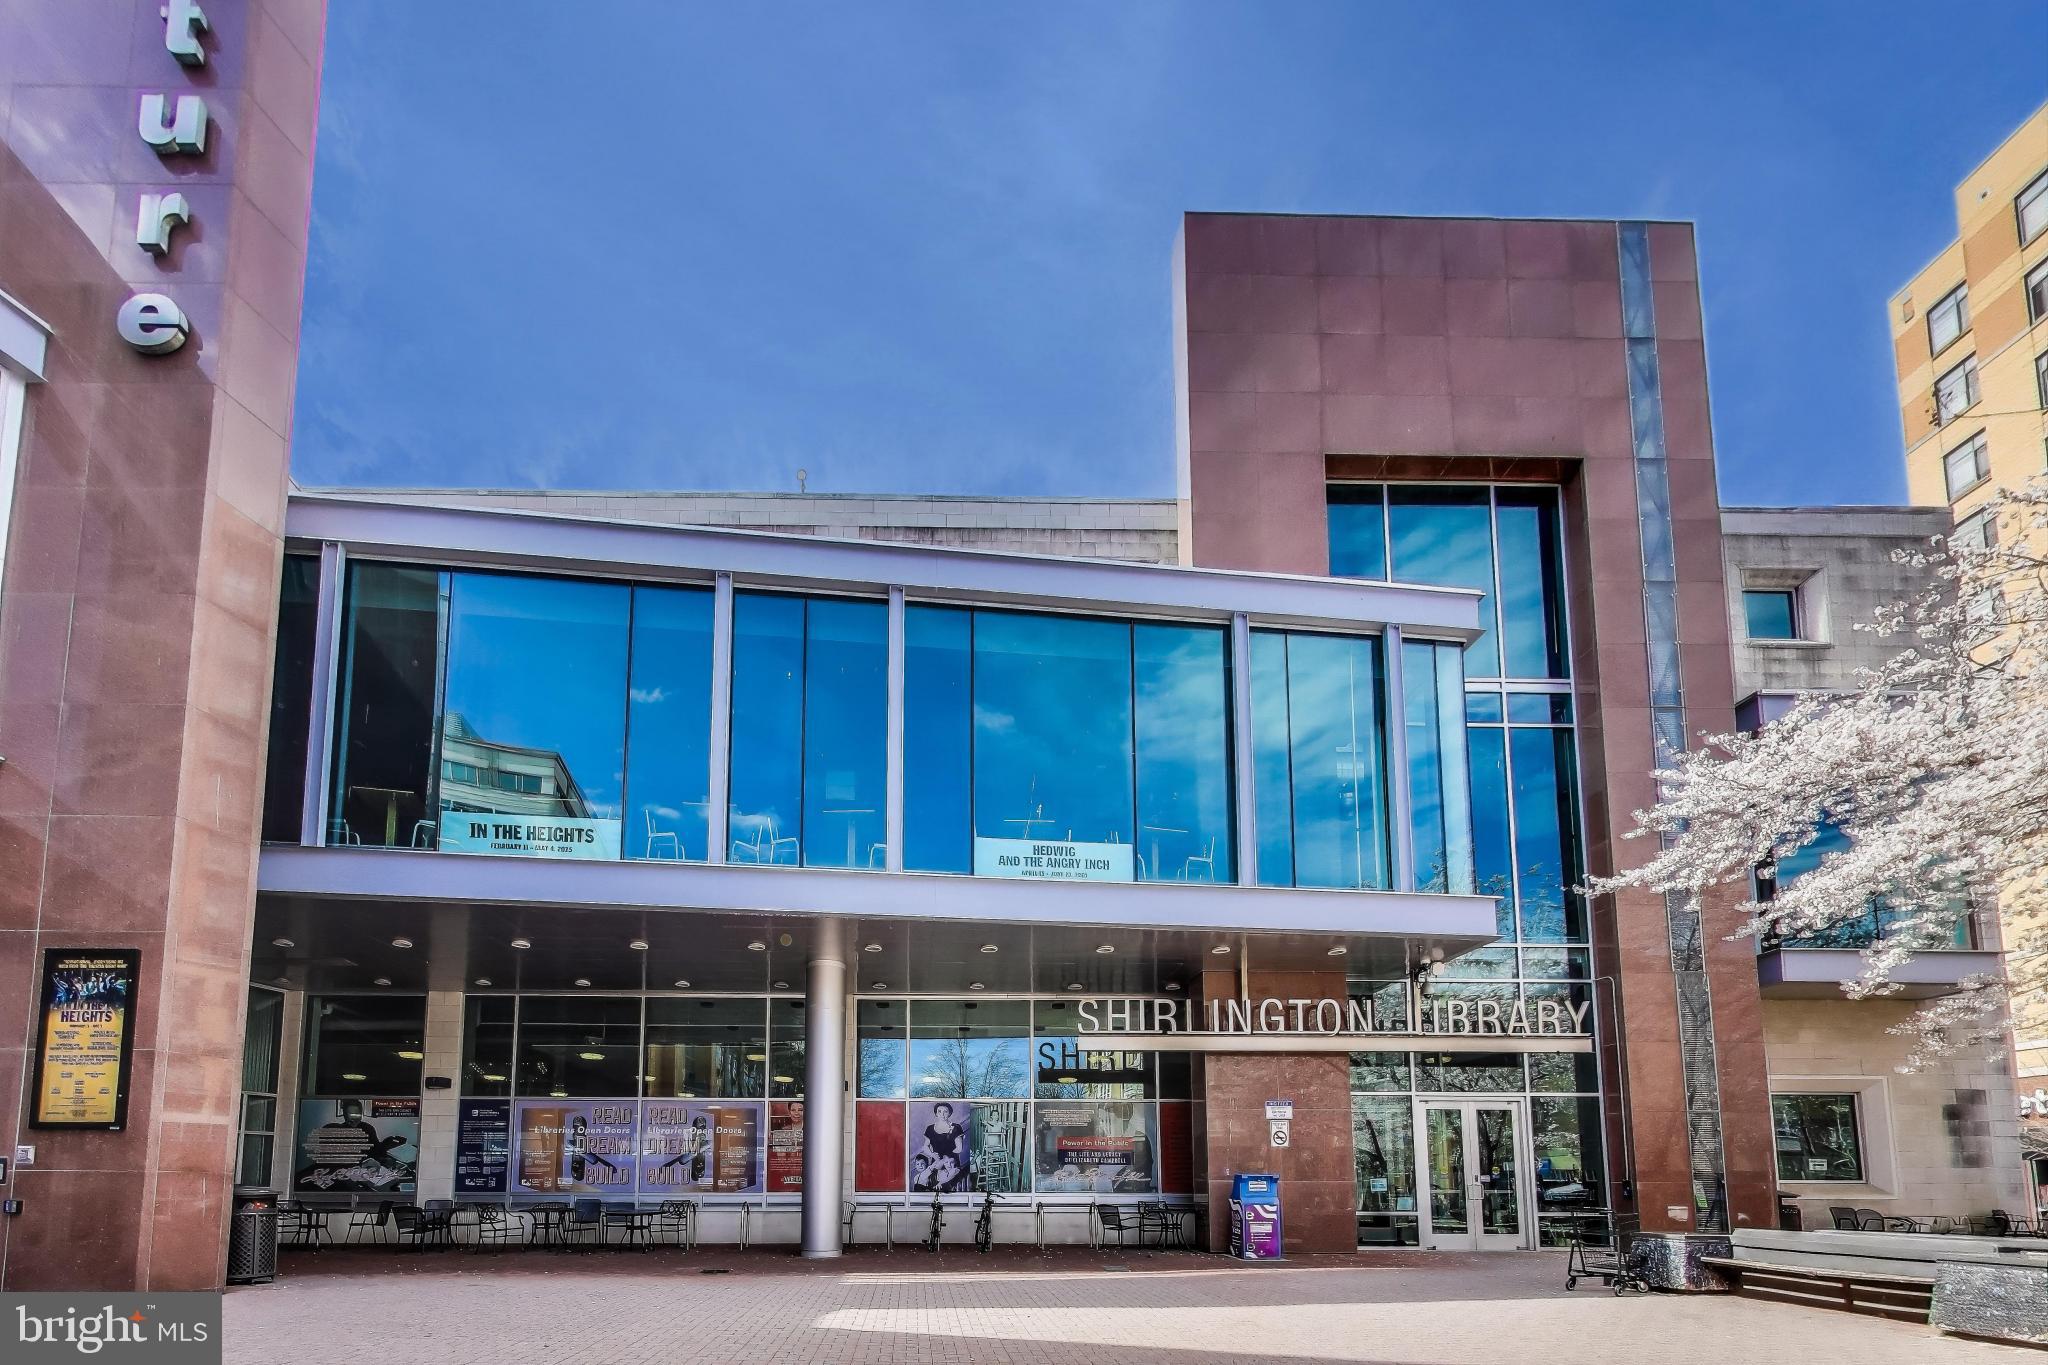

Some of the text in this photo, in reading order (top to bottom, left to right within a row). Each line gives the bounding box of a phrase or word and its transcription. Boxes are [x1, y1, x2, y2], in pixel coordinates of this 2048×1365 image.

[469, 822, 596, 843] IN THE HEIGHTS
[1033, 844, 1076, 857] HEDWIG
[998, 855, 1110, 870] AND THE ANGRY INCH
[60, 1011, 113, 1022] HEIGHTS
[1078, 998, 1374, 1035] SHIRLINGTON
[592, 1106, 632, 1124] READ
[648, 1106, 688, 1125] READ
[534, 1126, 631, 1136] Libraries Open Doors
[647, 1126, 743, 1136] Libraries Open Doors
[575, 1136, 632, 1155] DREAM
[645, 1136, 700, 1155] DREAM
[586, 1167, 630, 1185] BUILD
[647, 1167, 691, 1185] BUILD
